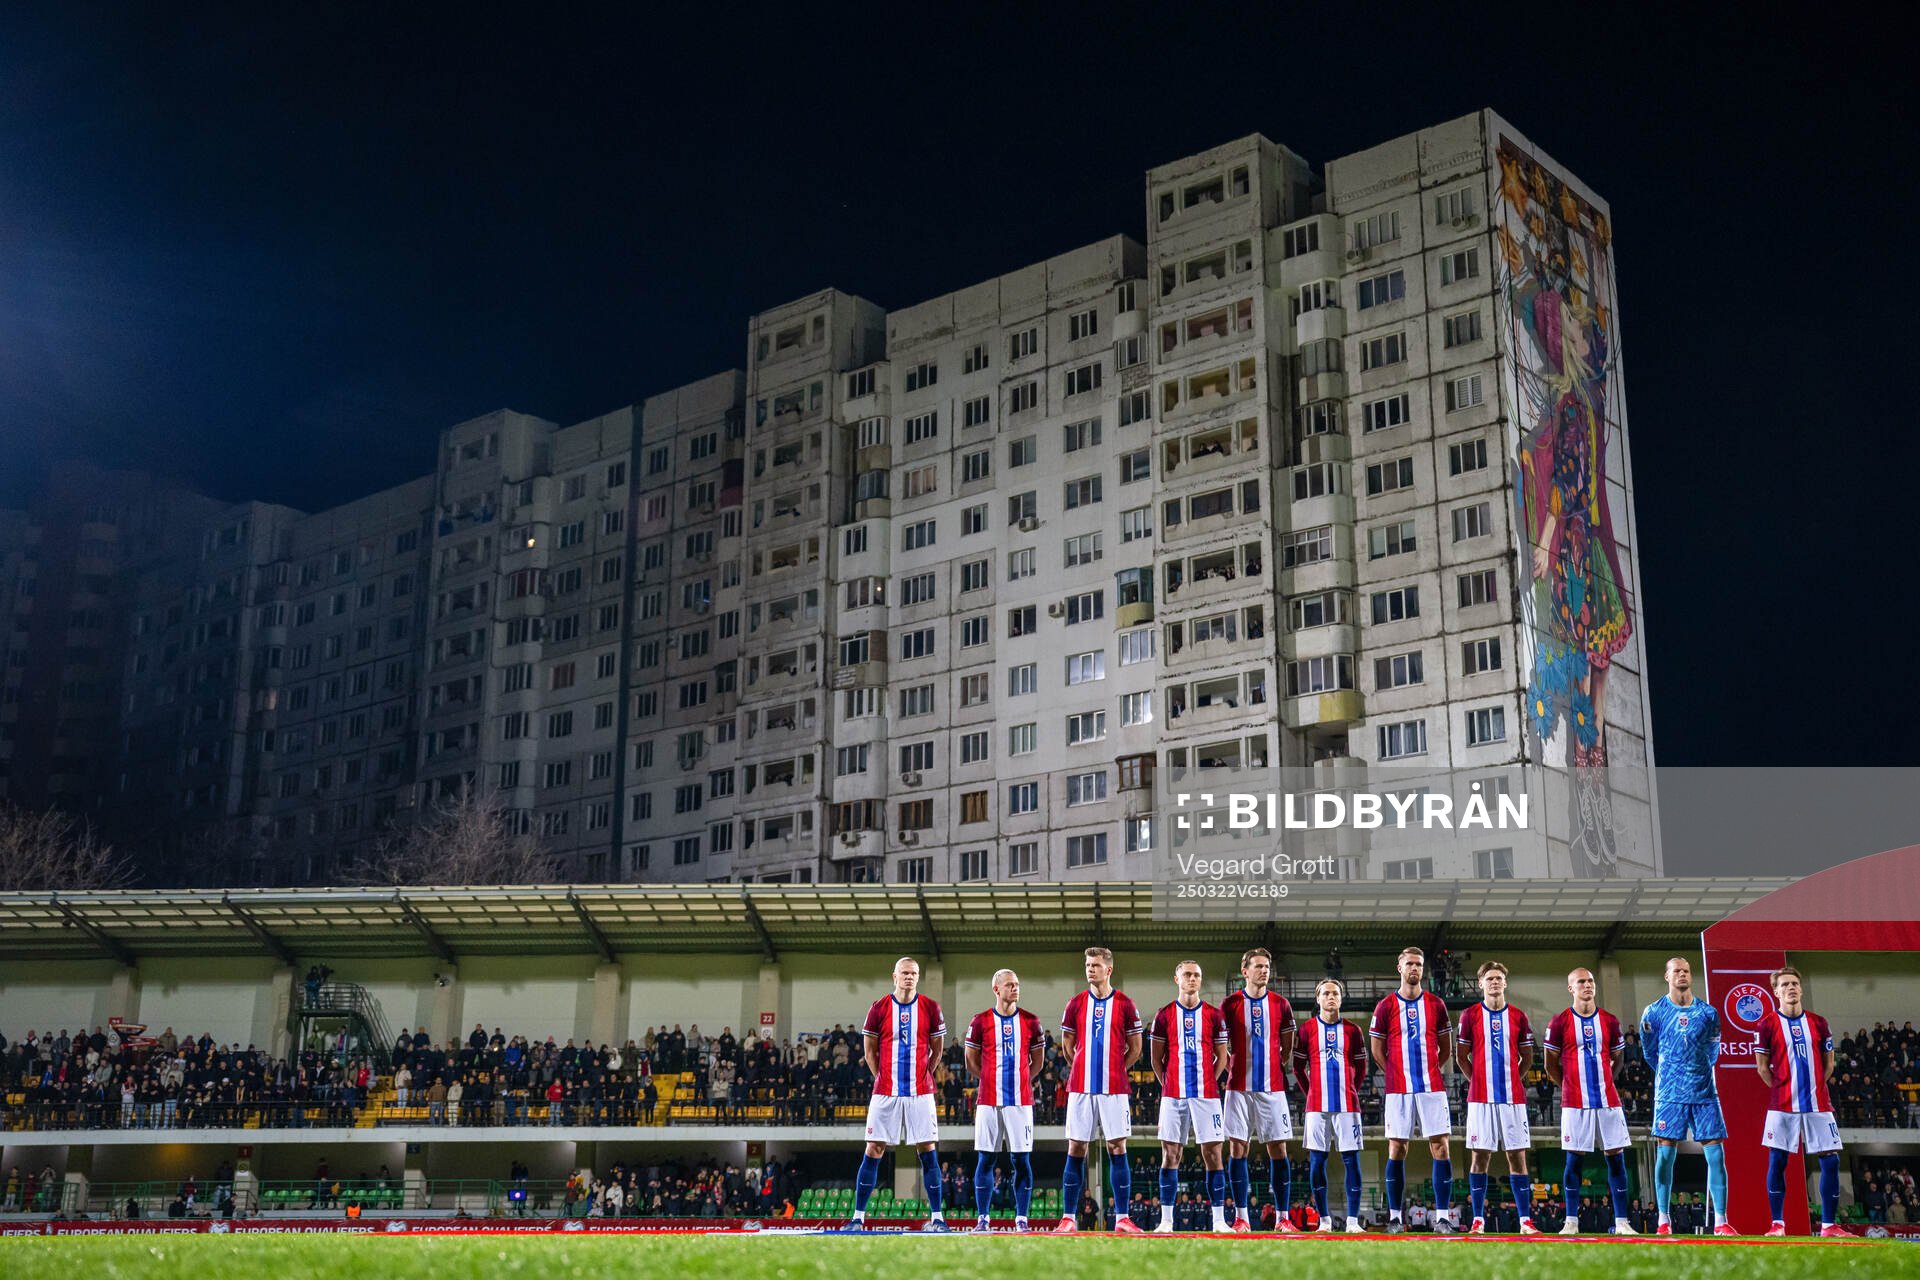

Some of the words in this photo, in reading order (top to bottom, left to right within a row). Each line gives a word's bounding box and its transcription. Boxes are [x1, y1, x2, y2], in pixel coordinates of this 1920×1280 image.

[1732, 987, 1763, 999] UEFA
[762, 1015, 773, 1023] 22
[1254, 1023, 1262, 1037] 8
[1410, 1025, 1418, 1039] 3
[1002, 1041, 1014, 1056] 14
[1184, 1035, 1195, 1050] 18
[1825, 1040, 1833, 1051] C
[1795, 1043, 1807, 1059] 10
[1212, 1113, 1222, 1129] 18
[1282, 1113, 1289, 1128] 8
[1828, 1122, 1839, 1138] 10
